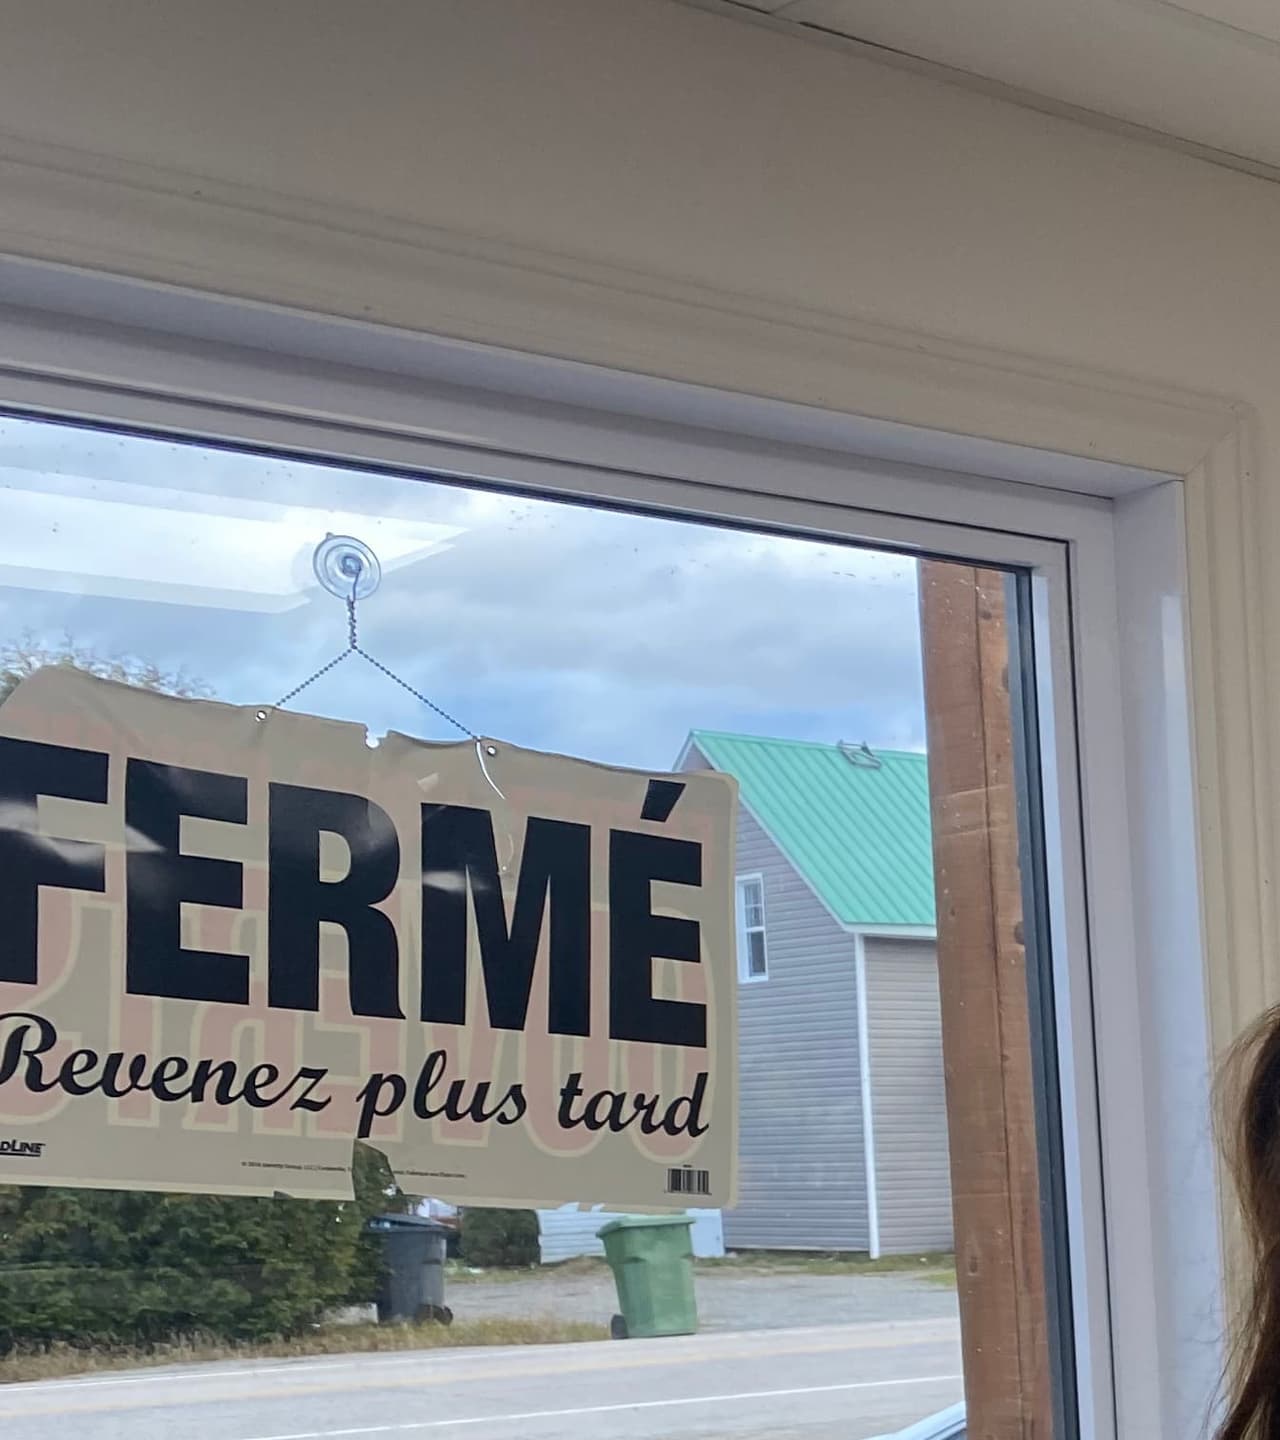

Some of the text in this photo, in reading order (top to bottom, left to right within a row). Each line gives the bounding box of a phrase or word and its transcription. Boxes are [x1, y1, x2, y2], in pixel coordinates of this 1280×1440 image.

[0, 735, 708, 1050] FERMÉ
[0, 1010, 711, 1140] Revenez plus tard
